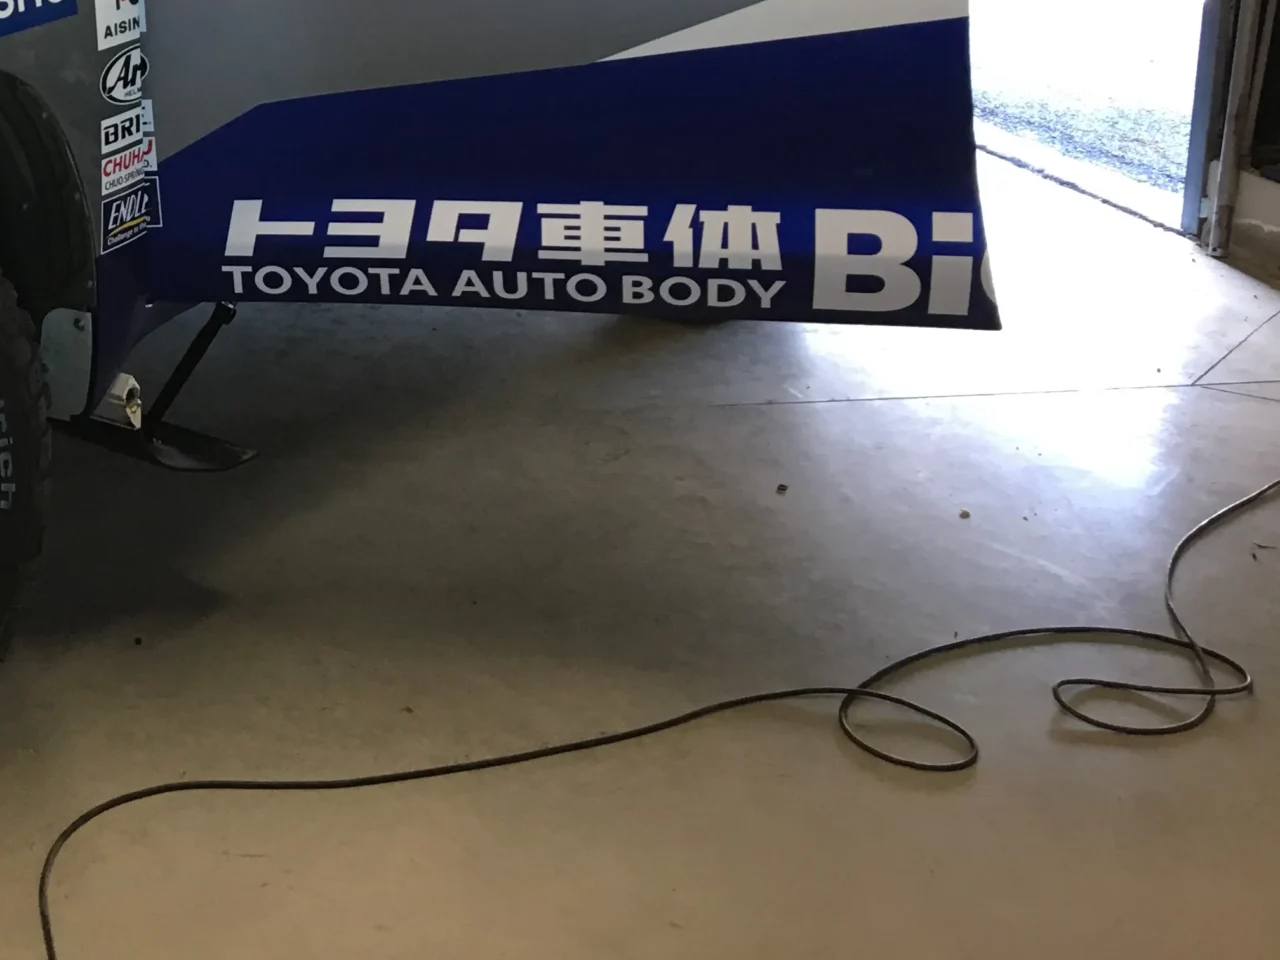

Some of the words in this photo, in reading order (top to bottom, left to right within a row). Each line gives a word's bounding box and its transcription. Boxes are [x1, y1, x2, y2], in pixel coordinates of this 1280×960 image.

[104, 15, 141, 40] AISIN
[224, 198, 785, 271] トヨタ車体
[811, 207, 983, 317] Bi
[222, 264, 438, 296] TOYOTA
[451, 268, 608, 303] AUTO
[621, 274, 788, 309] BODY
